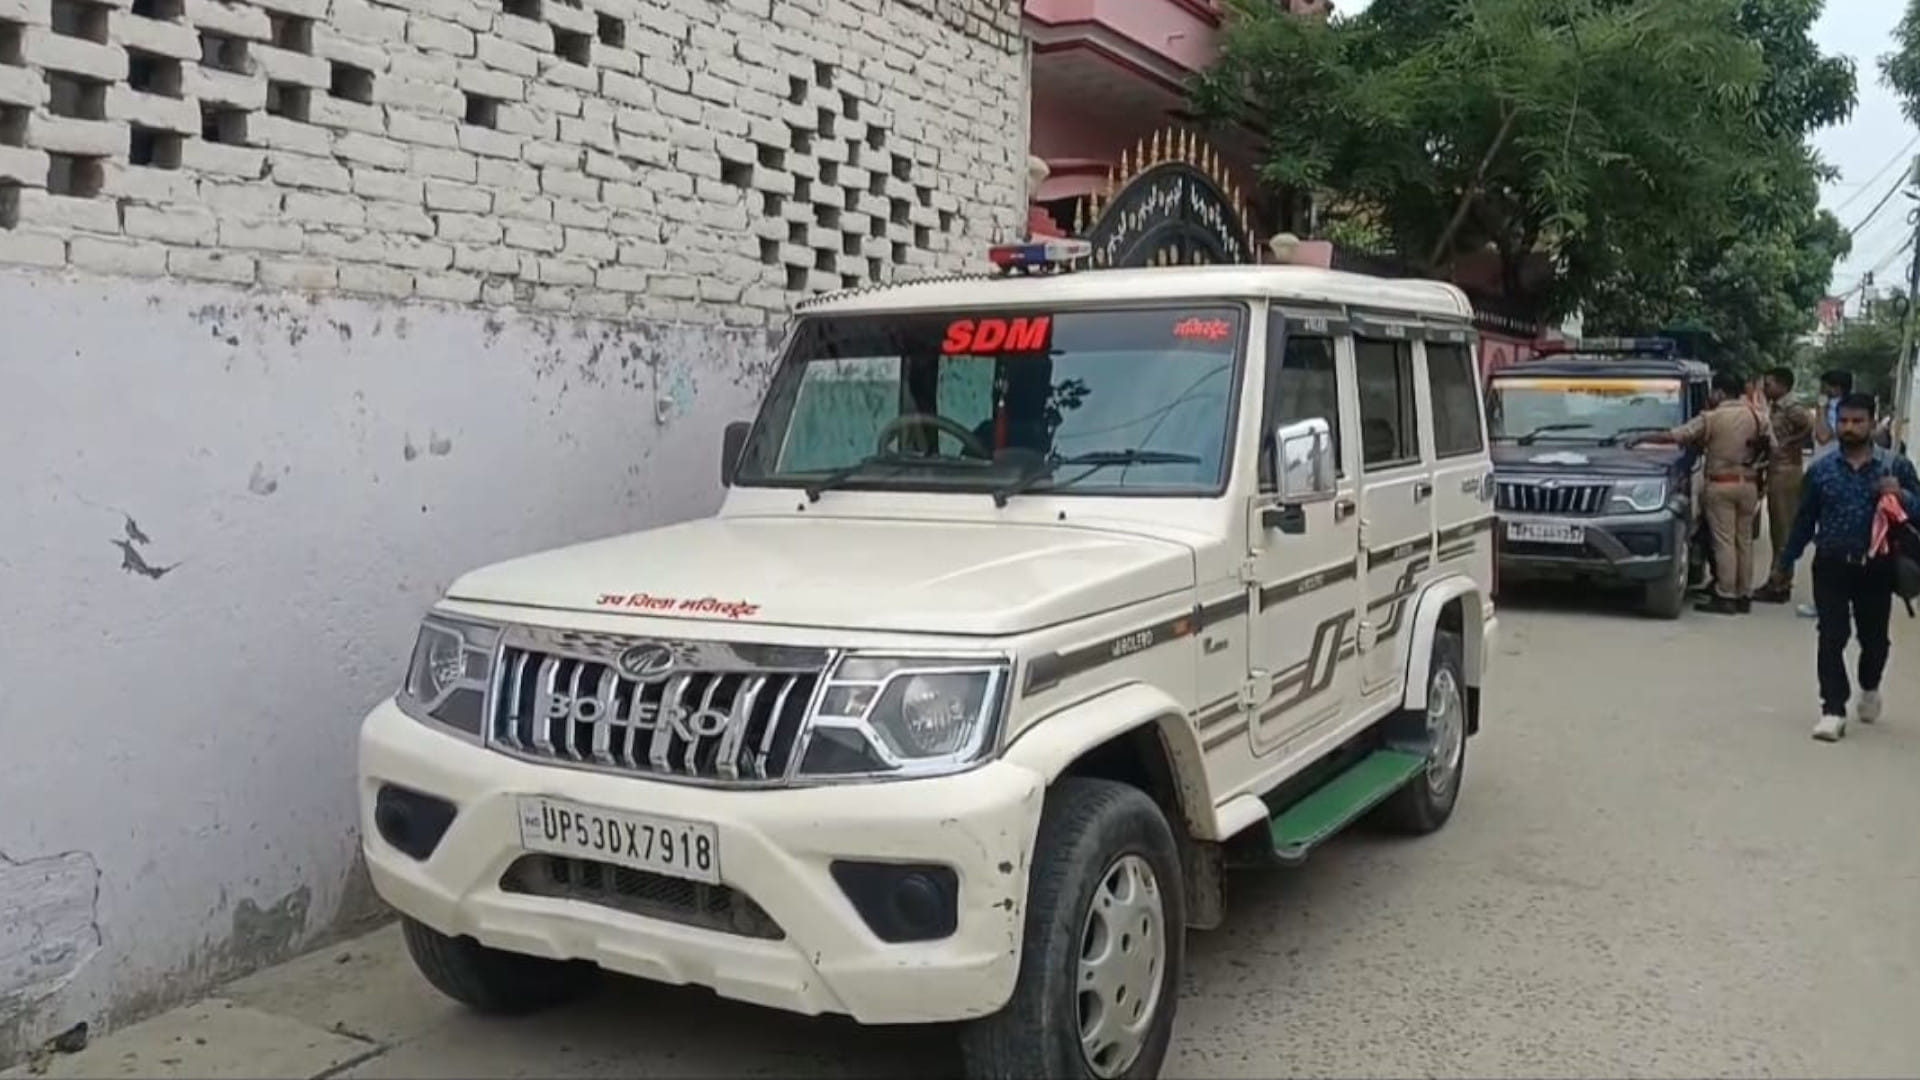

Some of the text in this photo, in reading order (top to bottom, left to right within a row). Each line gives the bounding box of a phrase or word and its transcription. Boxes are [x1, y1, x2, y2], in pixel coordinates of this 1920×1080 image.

[943, 317, 1050, 353] SDM
[597, 594, 623, 605] उप
[626, 593, 675, 609] जिला
[548, 693, 730, 742] BOLERO
[543, 805, 711, 870] UP53DX7918
